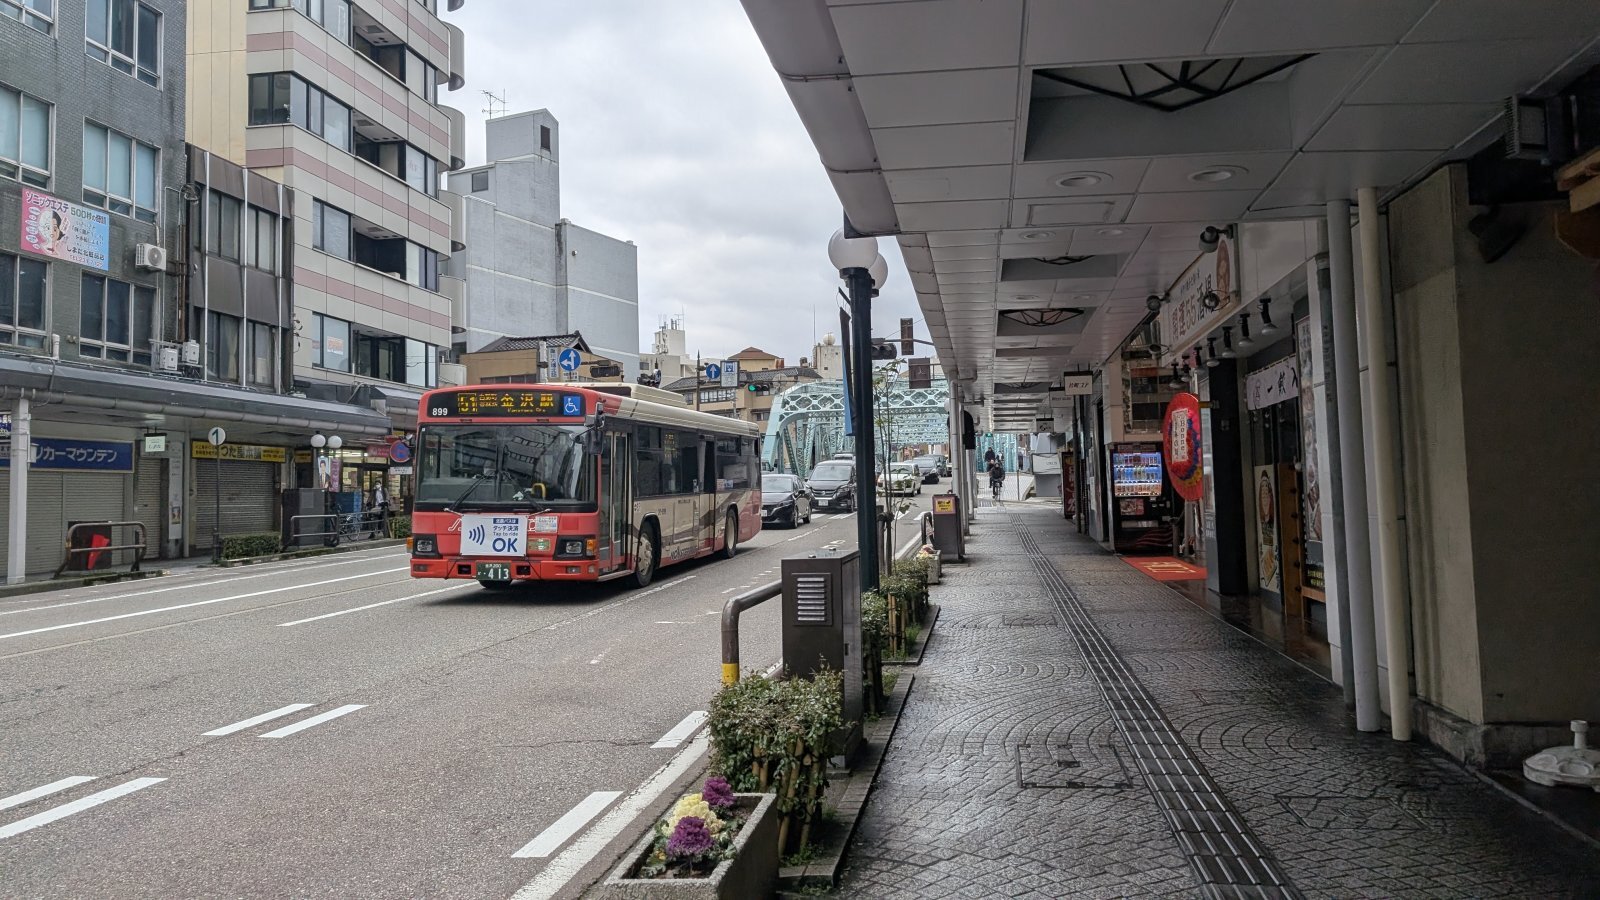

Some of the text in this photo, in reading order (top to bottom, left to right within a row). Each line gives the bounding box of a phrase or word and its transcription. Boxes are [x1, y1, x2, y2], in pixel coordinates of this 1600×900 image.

[25, 190, 69, 213] ソニックエステ
[458, 396, 477, 412] 51
[501, 393, 554, 407] 金沢駅
[432, 407, 448, 416] 899
[212, 428, 219, 444] 1
[492, 537, 518, 553] OK
[488, 568, 509, 579] 413
